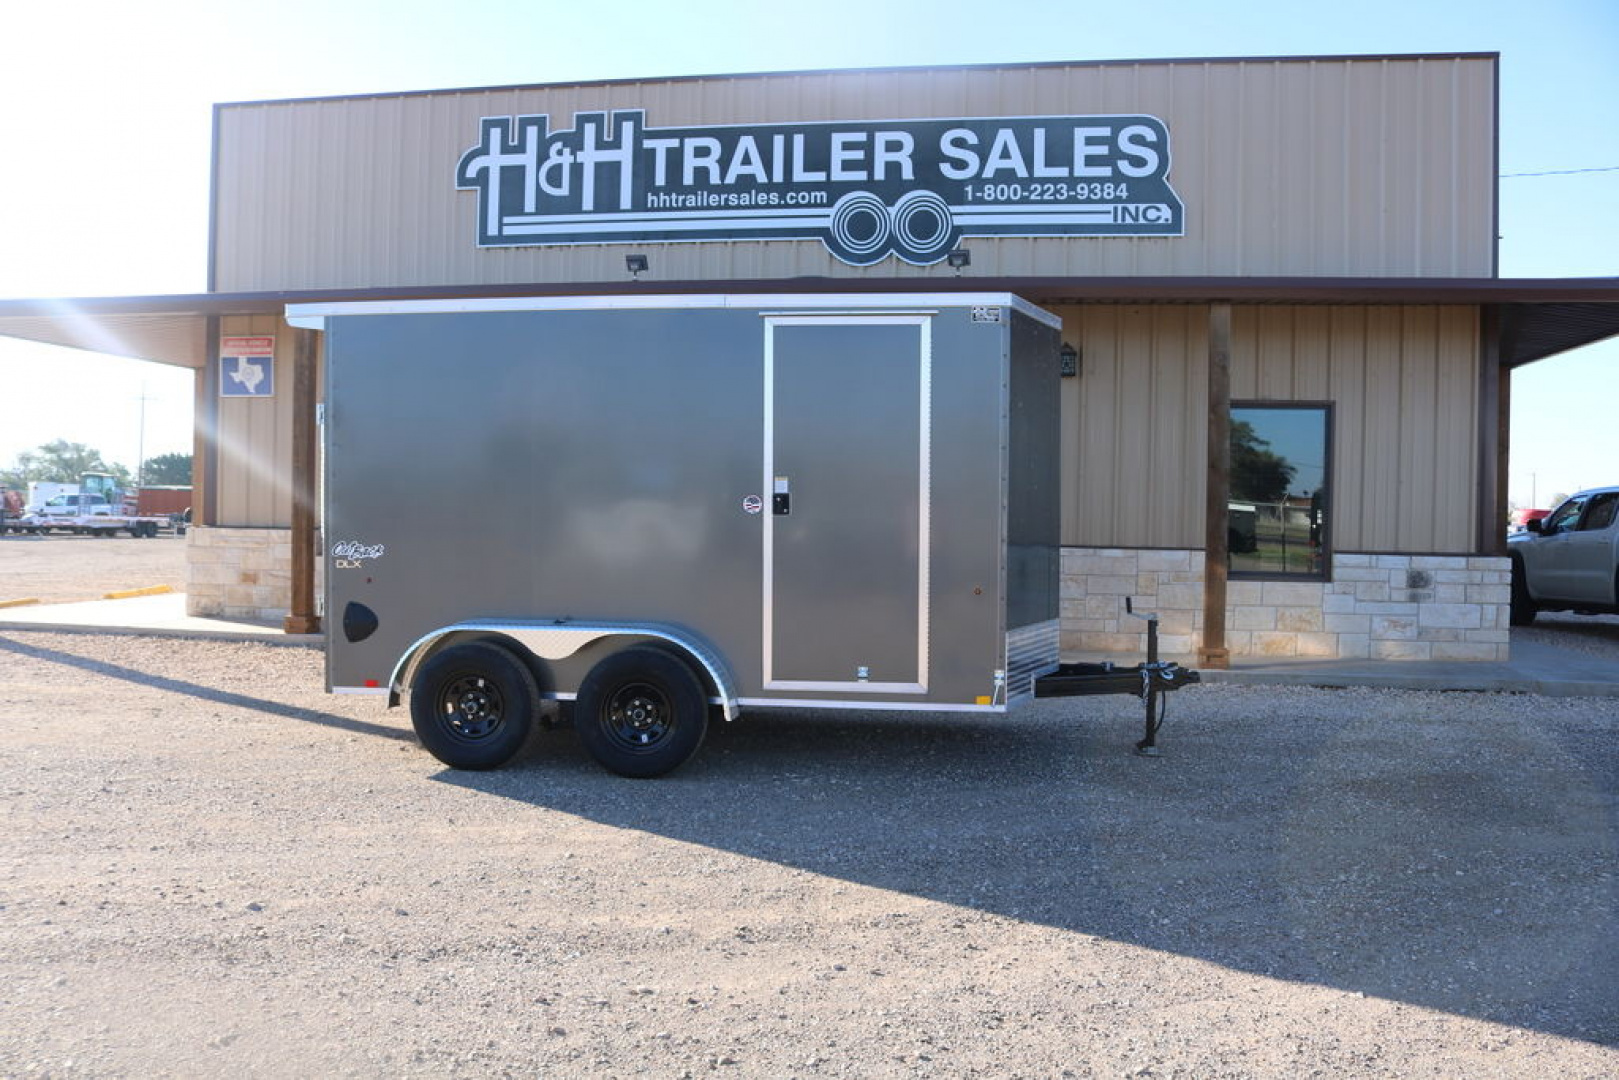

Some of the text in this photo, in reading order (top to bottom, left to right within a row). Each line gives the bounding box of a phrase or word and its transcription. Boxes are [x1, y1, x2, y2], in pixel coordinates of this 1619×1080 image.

[465, 121, 1160, 236] H&H TRAILER SALES
[647, 190, 828, 208] hhtrailersales.com
[963, 182, 1129, 201] 1-800-223-9384
[1112, 205, 1170, 224] INC.
